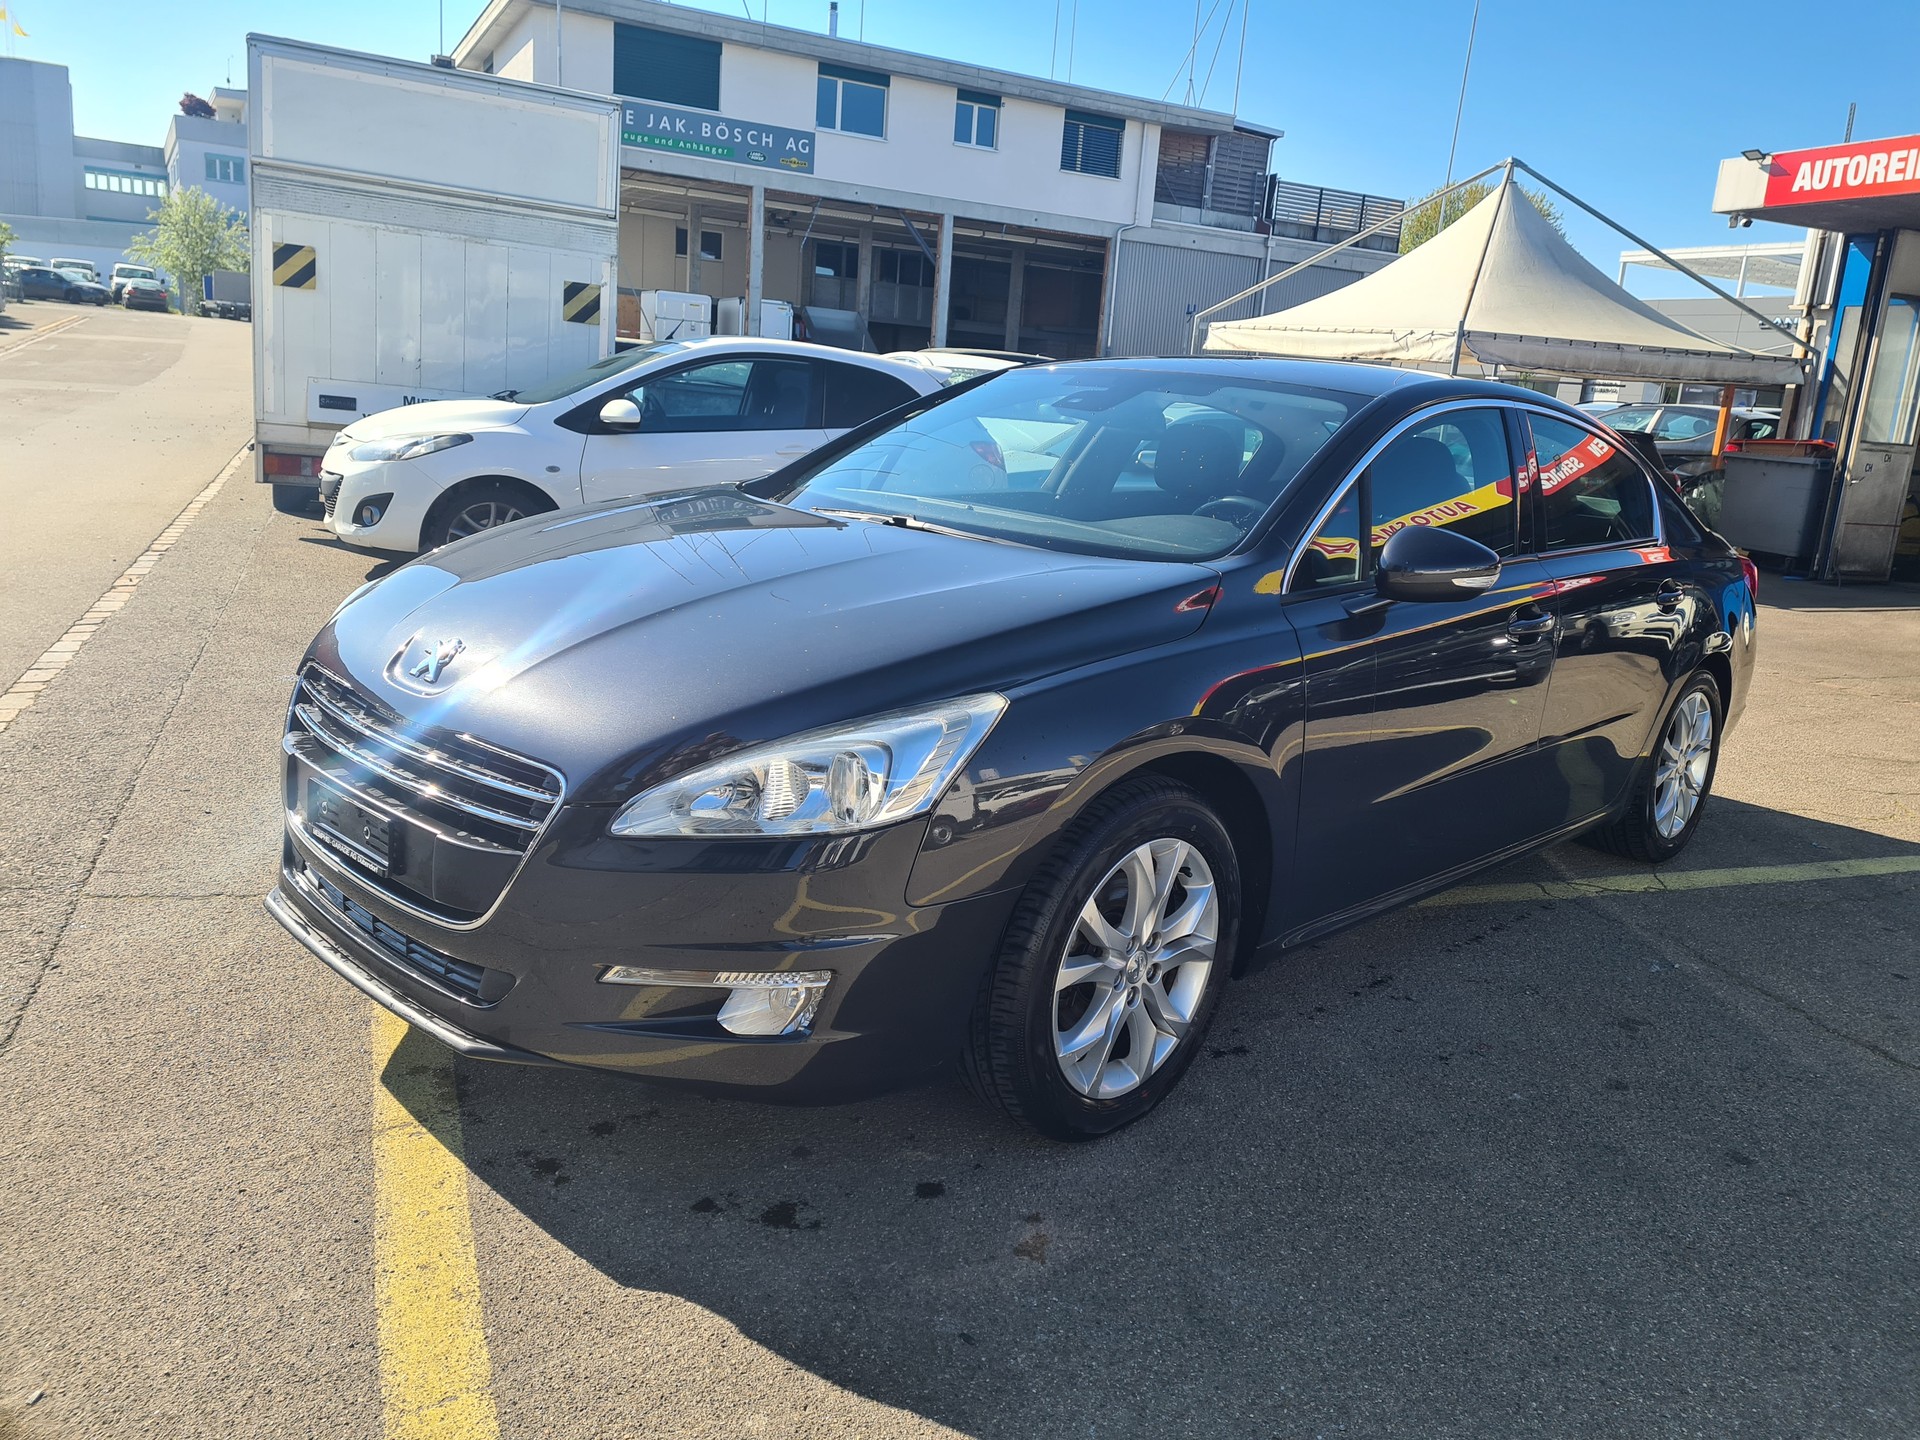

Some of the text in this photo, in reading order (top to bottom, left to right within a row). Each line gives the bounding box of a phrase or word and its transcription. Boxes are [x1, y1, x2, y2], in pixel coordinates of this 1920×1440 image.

[646, 113, 694, 135] JAK.
[701, 122, 773, 148] BÖSCH
[785, 136, 810, 154] AG
[654, 138, 673, 146] und
[678, 140, 729, 155] Anhänger
[1791, 148, 1920, 193] AUTOREI
